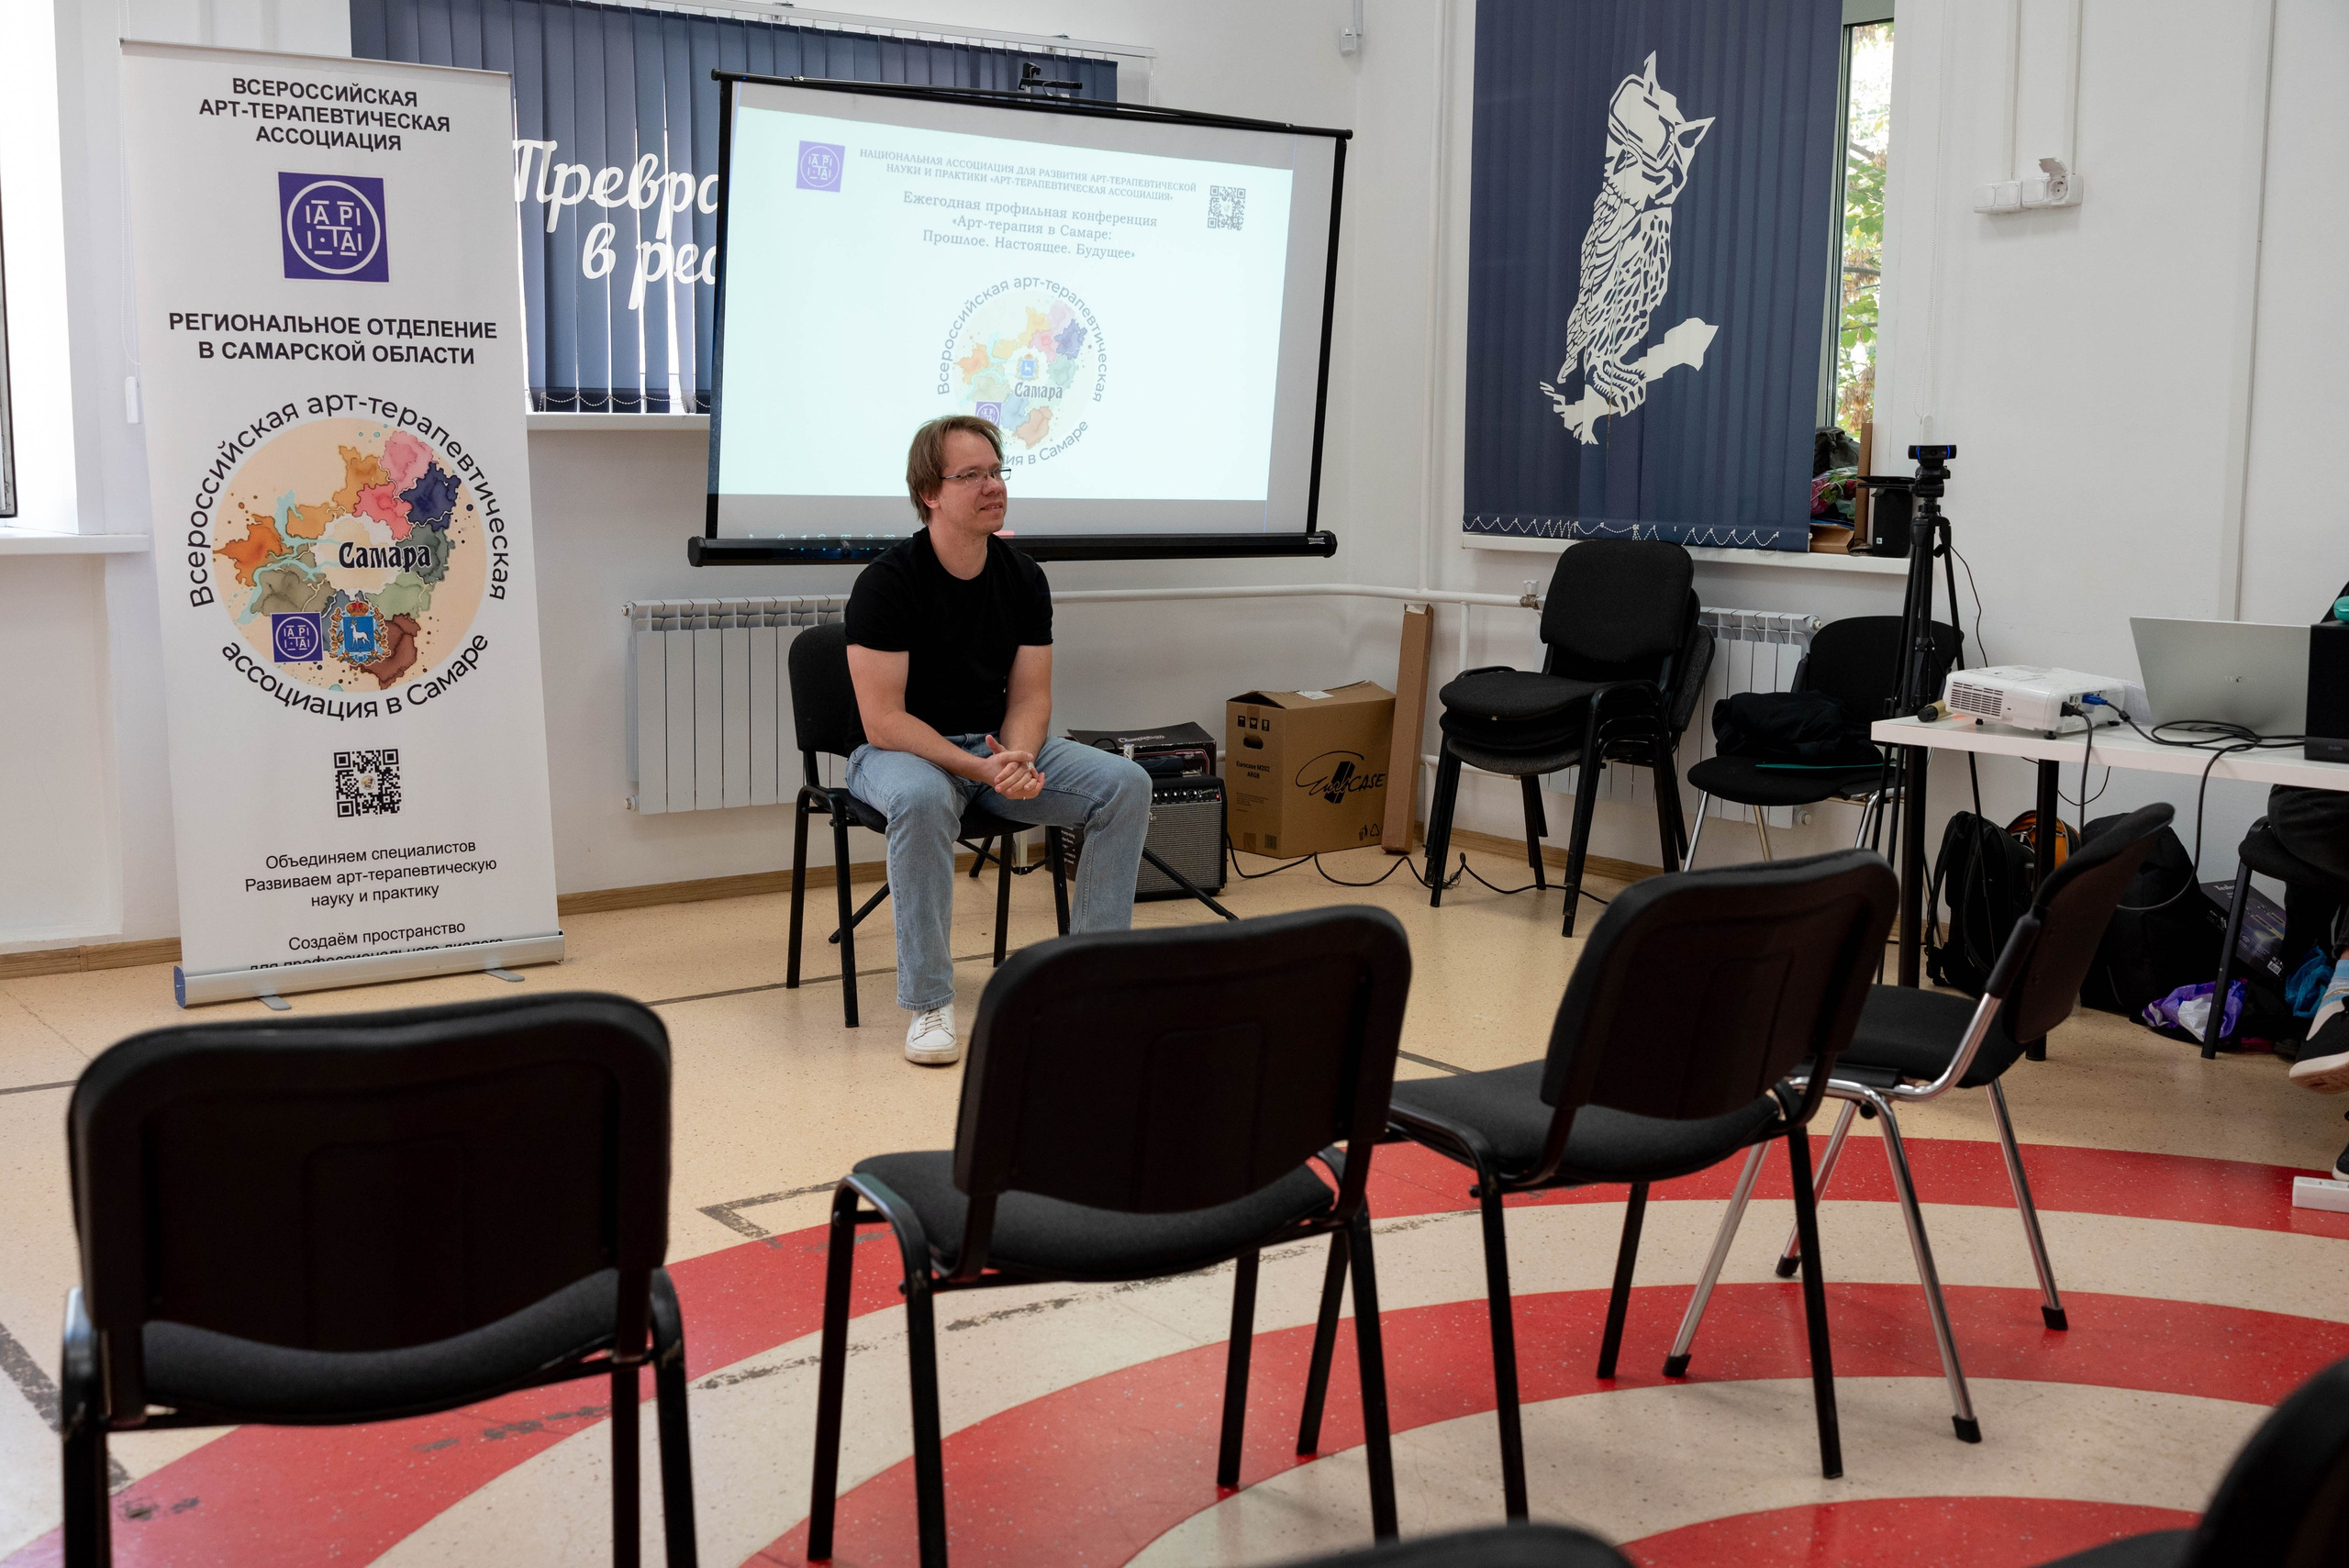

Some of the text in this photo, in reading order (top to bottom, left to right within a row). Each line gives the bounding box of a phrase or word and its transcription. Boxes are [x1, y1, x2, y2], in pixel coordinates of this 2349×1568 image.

[233, 78, 417, 106] ВСЕРОССИЙСКАЯ
[199, 99, 451, 132] АРТ-ТЕРАПЕВТИЧЕСКАЯ
[256, 127, 401, 151] АССОЦИАЦИЯ
[860, 149, 1197, 192] НАЦИОНАЛЬНАЯ АССОЦИАЦИЯ ДЛЯ РАЗВИТИЯ АРТ-ТЕРАПЕВТИЧЕСКОЙ
[886, 163, 920, 175] НАУКИ
[924, 168, 931, 176] И
[935, 169, 987, 183] ПРАКТИКИ
[903, 191, 1157, 227] Ежегодная профильная конференция
[952, 216, 1112, 240] «Арт-терапия в Самаре:
[582, 222, 617, 280] в
[923, 229, 1136, 260] Прошлое. Настоящее. Будущее»
[169, 312, 497, 339] РЕГИОНАЛЬНОЕ ОТДЕЛЕНИЕ
[937, 276, 1108, 403] Всероссийская арт-терапевтическая
[199, 340, 474, 364] В САМАРСКОЙ ОБЛАСТИ
[1014, 382, 1063, 402] Самара
[1029, 454, 1037, 465] в
[1040, 419, 1088, 461] Самаре
[187, 394, 509, 607] Всероссийская арт-терапевтическая
[339, 541, 430, 573] Самара
[222, 634, 488, 721] ассоциация в Самаре
[1236, 761, 1256, 770] Eurocase
[265, 840, 475, 870] Объединяем специалистов
[245, 858, 496, 893] Развиваем арт-терапевтическую
[311, 884, 440, 909] науку и практику
[289, 932, 358, 951] Создаём
[363, 923, 465, 944] пространство
